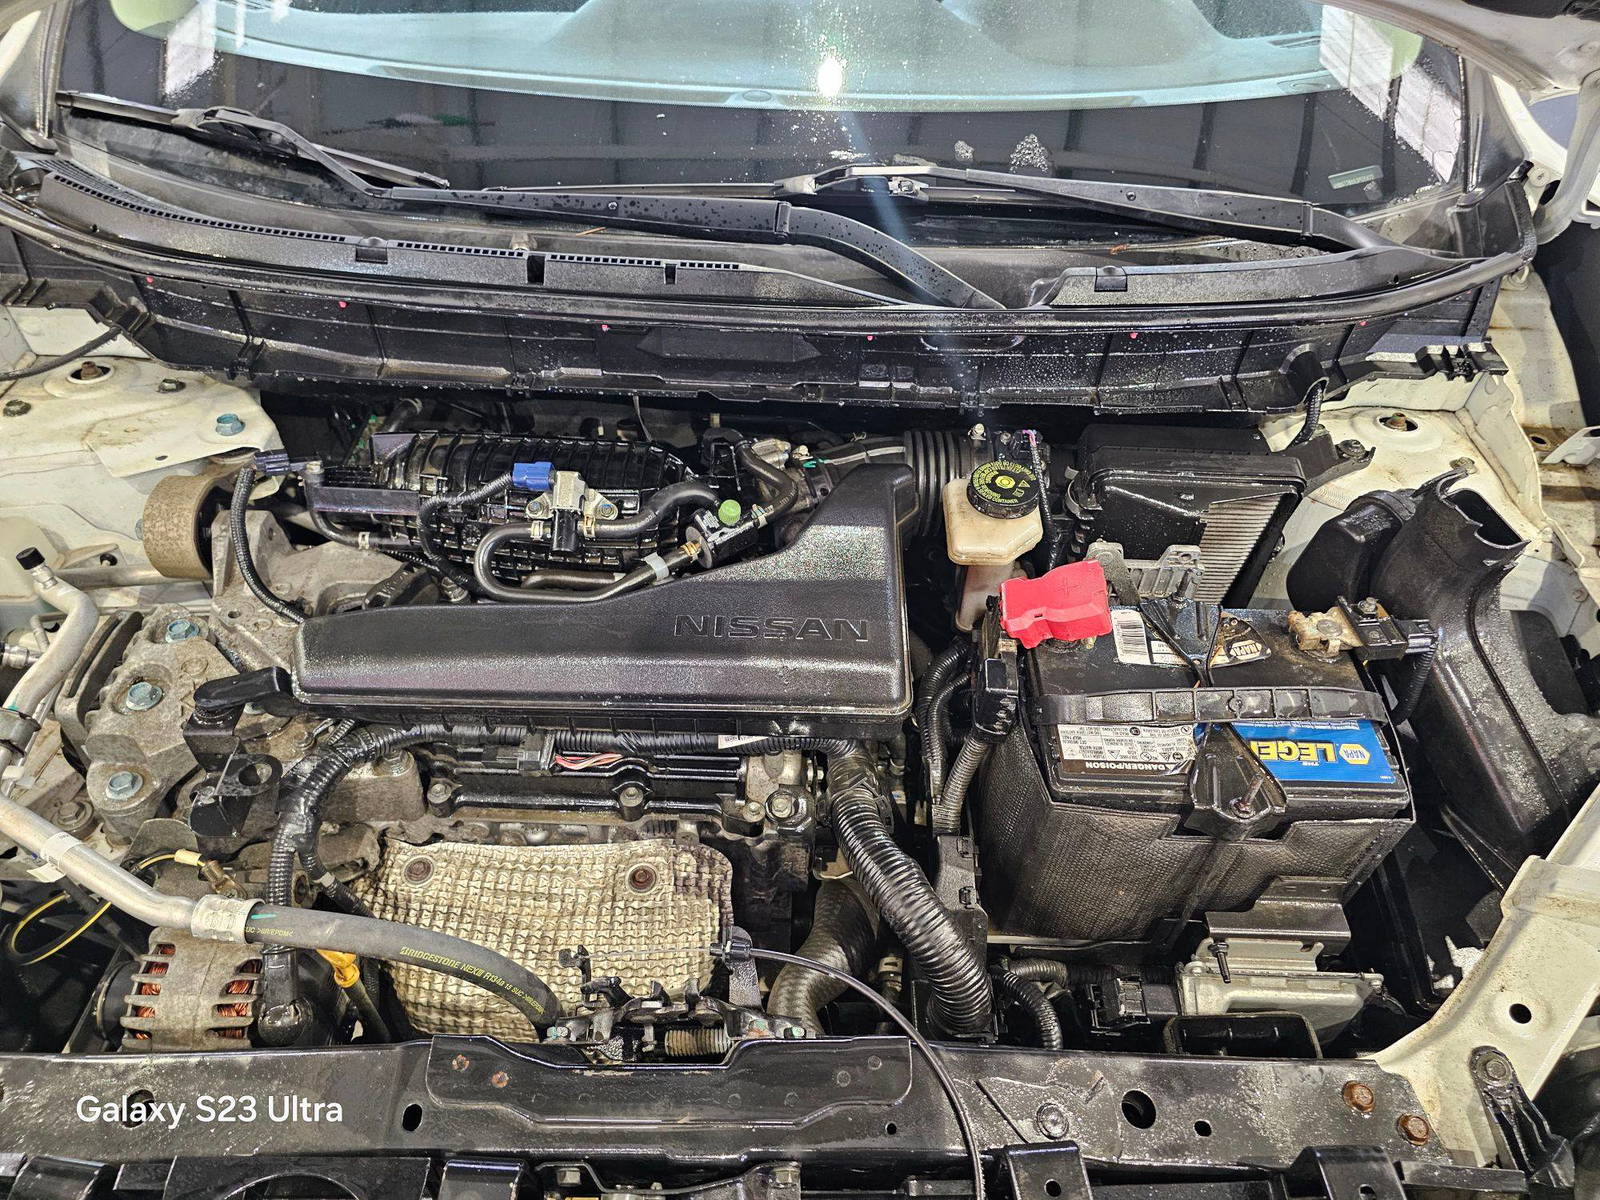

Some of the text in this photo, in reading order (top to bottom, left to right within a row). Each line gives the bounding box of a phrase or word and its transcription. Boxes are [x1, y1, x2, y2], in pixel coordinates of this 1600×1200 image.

[673, 614, 869, 642] NISSAN
[1233, 643, 1257, 657] NAPA
[1342, 748, 1366, 759] NAPA
[1085, 761, 1166, 771] DANGER/POISON
[399, 946, 461, 969] BRIDGESTONE
